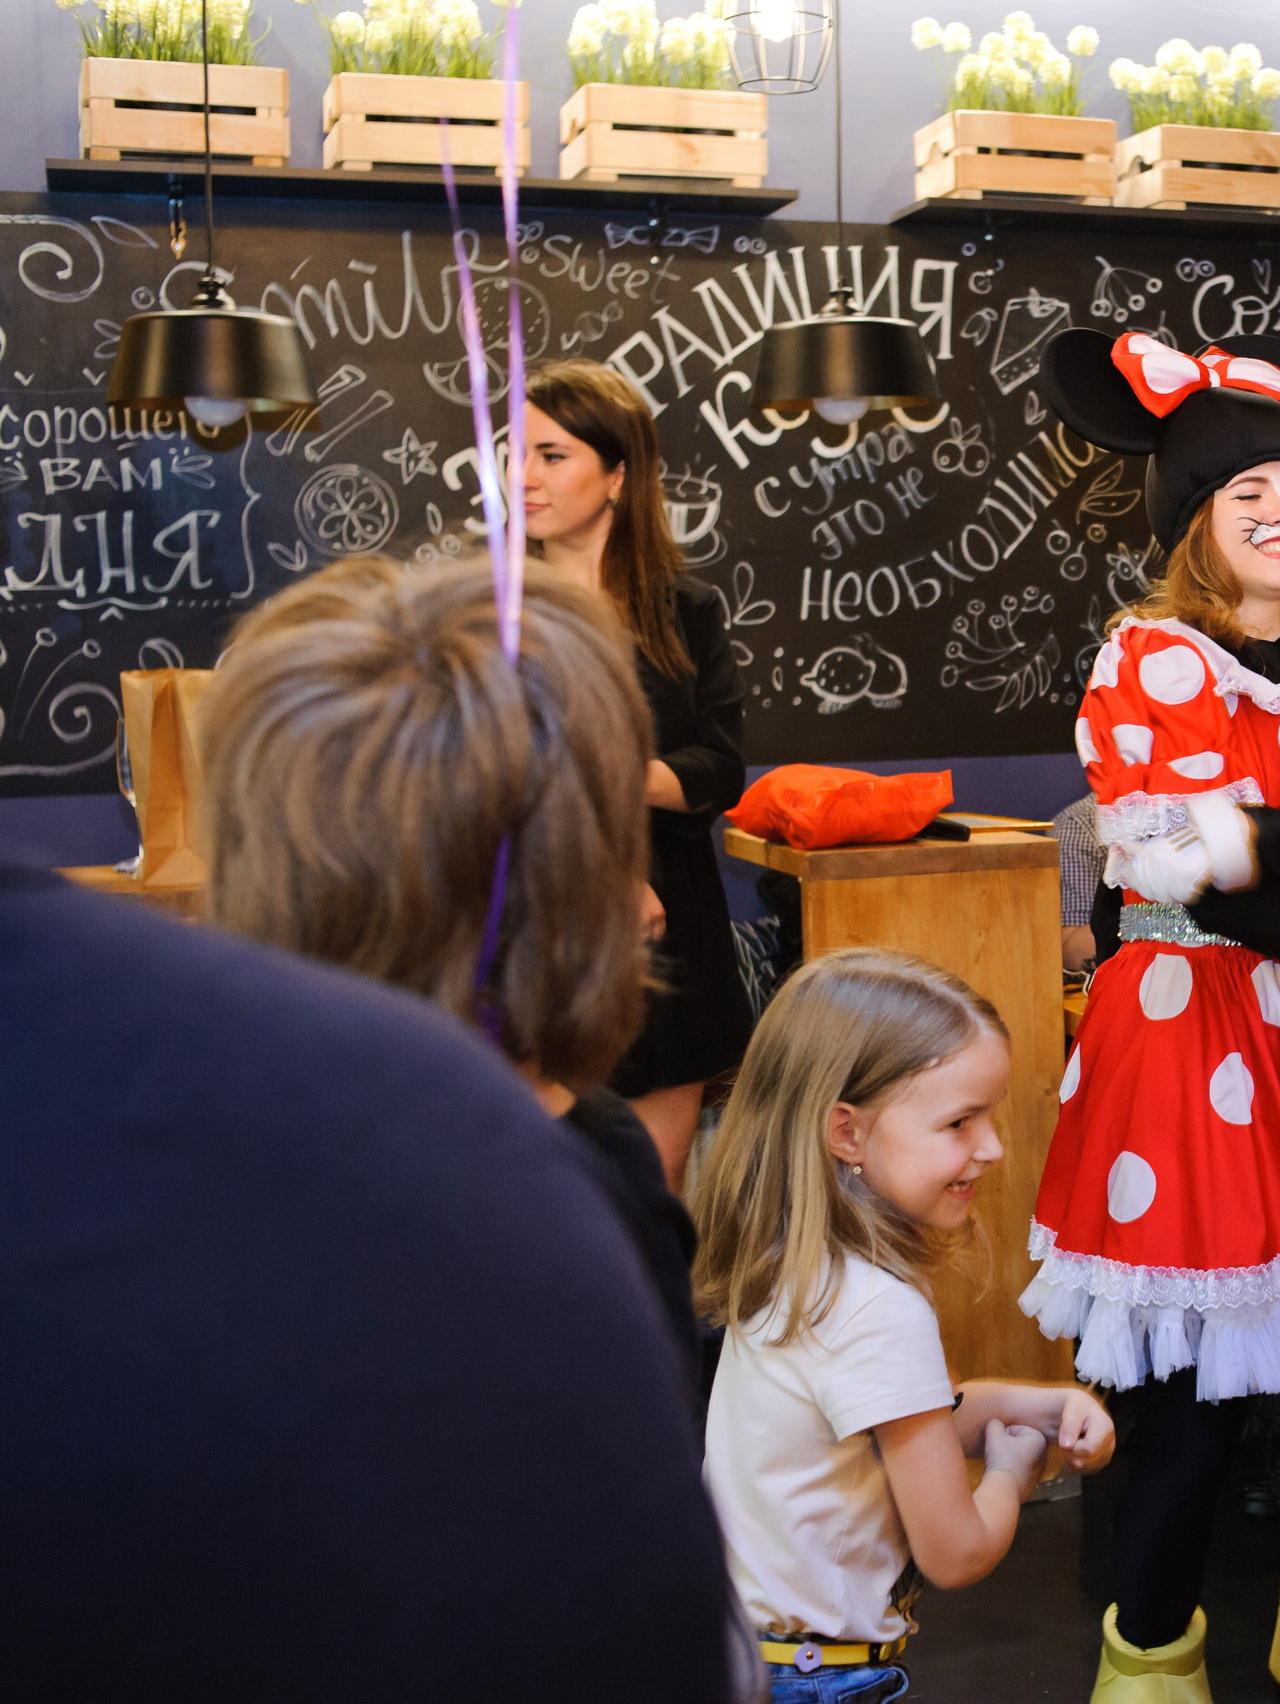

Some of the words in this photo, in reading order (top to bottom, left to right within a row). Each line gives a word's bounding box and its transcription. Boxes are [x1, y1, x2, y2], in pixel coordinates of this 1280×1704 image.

[601, 245, 959, 421] РАДИЦИЯ
[39, 456, 163, 496] ВАМ
[0, 509, 222, 601] ДНЯ
